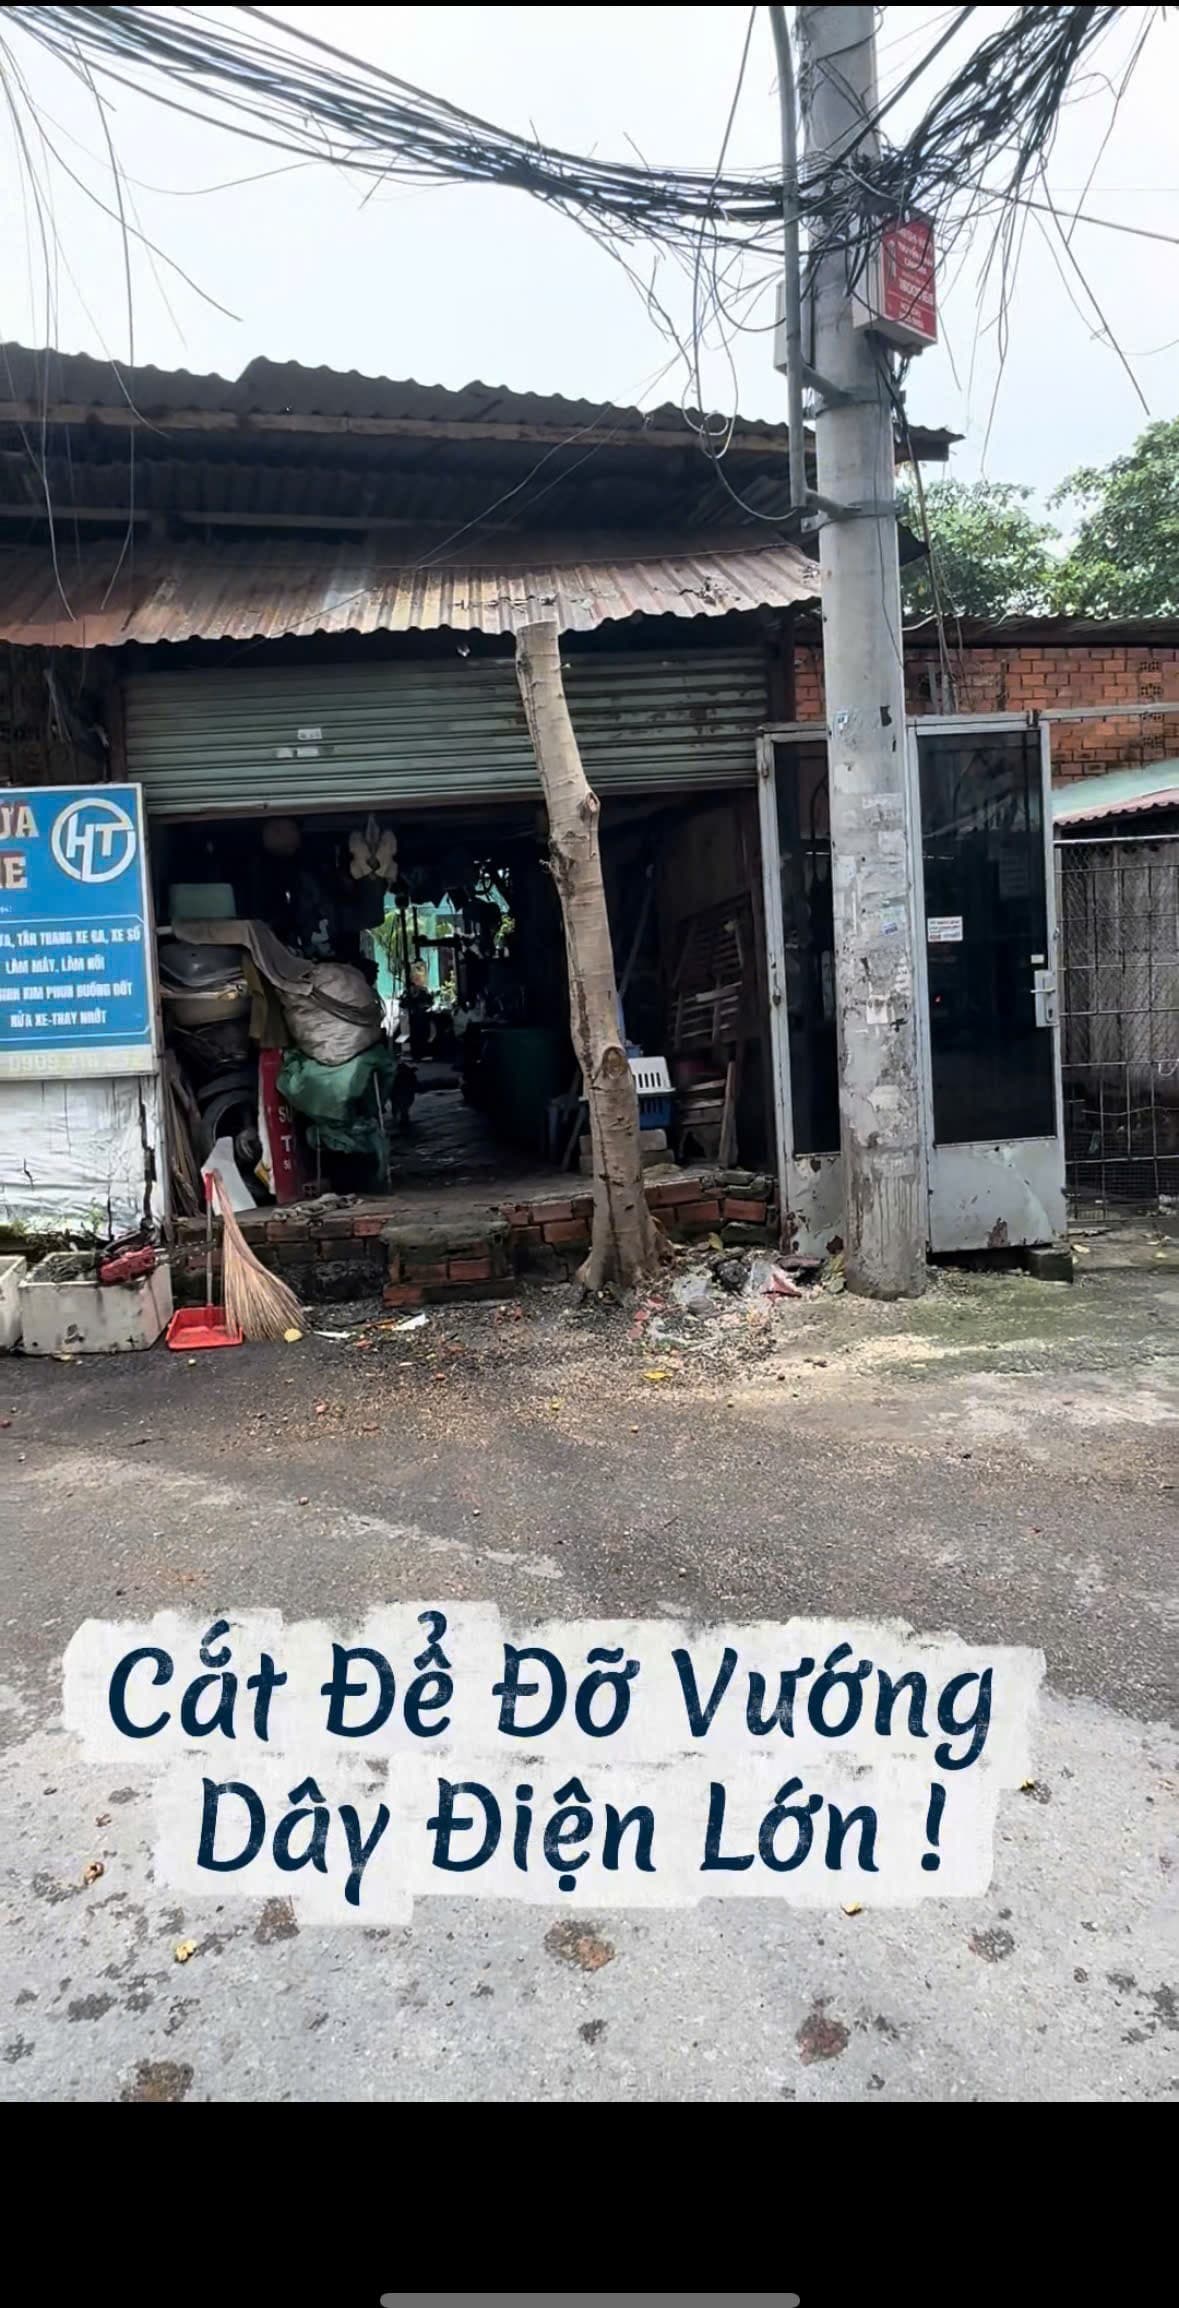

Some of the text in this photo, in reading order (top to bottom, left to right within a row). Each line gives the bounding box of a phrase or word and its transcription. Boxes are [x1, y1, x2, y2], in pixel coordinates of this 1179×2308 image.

[17, 929, 37, 947] TÂN
[40, 931, 73, 946] TRANG
[76, 930, 89, 944] XE
[111, 928, 124, 942] XE
[127, 924, 142, 941] SỐ
[61, 955, 85, 972] LÀM
[23, 986, 44, 1000] KIM
[46, 984, 74, 999] PHUN
[10, 1009, 33, 1028] RỬA
